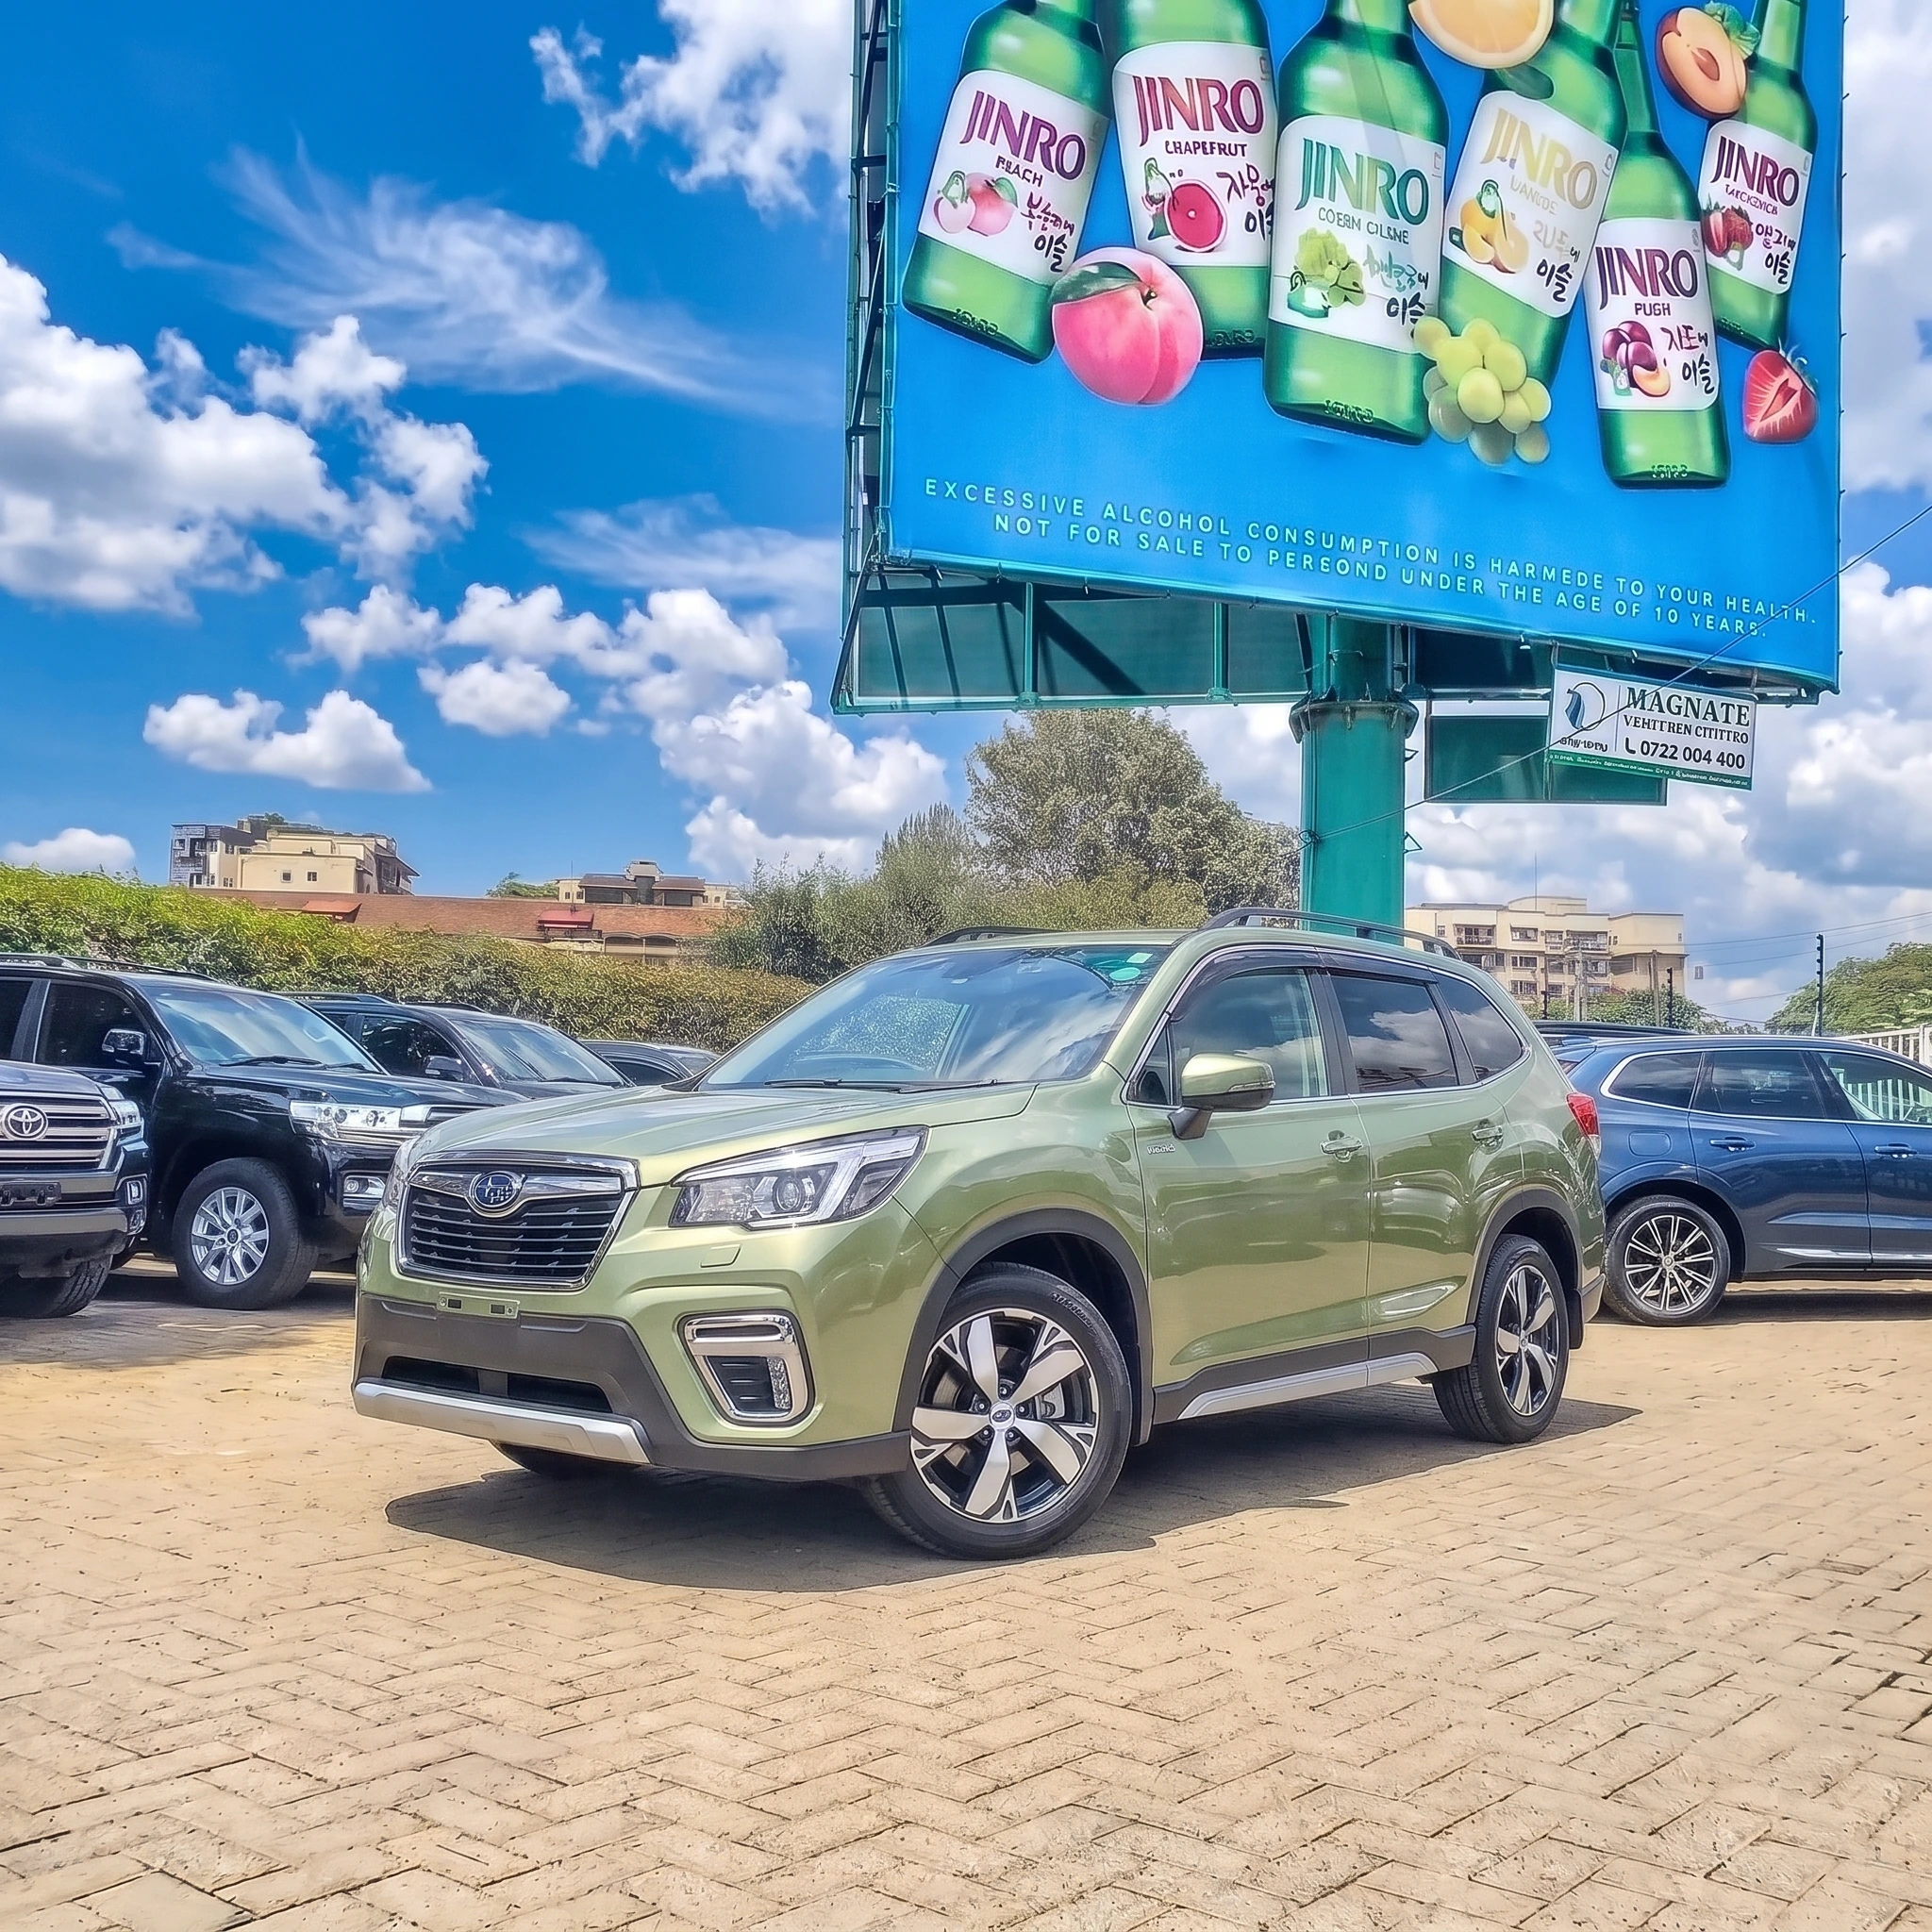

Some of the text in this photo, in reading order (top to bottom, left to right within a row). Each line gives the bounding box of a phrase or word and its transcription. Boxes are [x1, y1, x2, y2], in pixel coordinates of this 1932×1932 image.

[959, 91, 1086, 181] JINRO
[1133, 75, 1264, 147] JINRO
[1294, 138, 1429, 225] JINRO
[1480, 108, 1598, 209] JINRO
[1710, 136, 1800, 207] JINRO
[1595, 247, 1698, 310] JINRO
[925, 478, 1084, 517] EXCESSIVE
[1103, 503, 1230, 535] ALCOHOL
[1248, 523, 1439, 564] CONSUMPTION
[1454, 552, 1476, 570] IS
[1490, 558, 1604, 591] HARMEDE
[1616, 577, 1644, 596] TO
[1657, 584, 1713, 607] YOUR
[995, 514, 1050, 537] NOT
[1070, 524, 1120, 546] FOR
[1138, 533, 1204, 557] SALE
[1220, 542, 1251, 563] TO
[1402, 568, 1484, 595] UNDER
[1498, 582, 1542, 604] THE
[1557, 591, 1601, 612] AGE
[1615, 600, 1641, 618] OF
[1656, 607, 1678, 624] 10
[1626, 687, 1750, 727] MAGNATE
[1640, 741, 1745, 770] 0722 004 400
